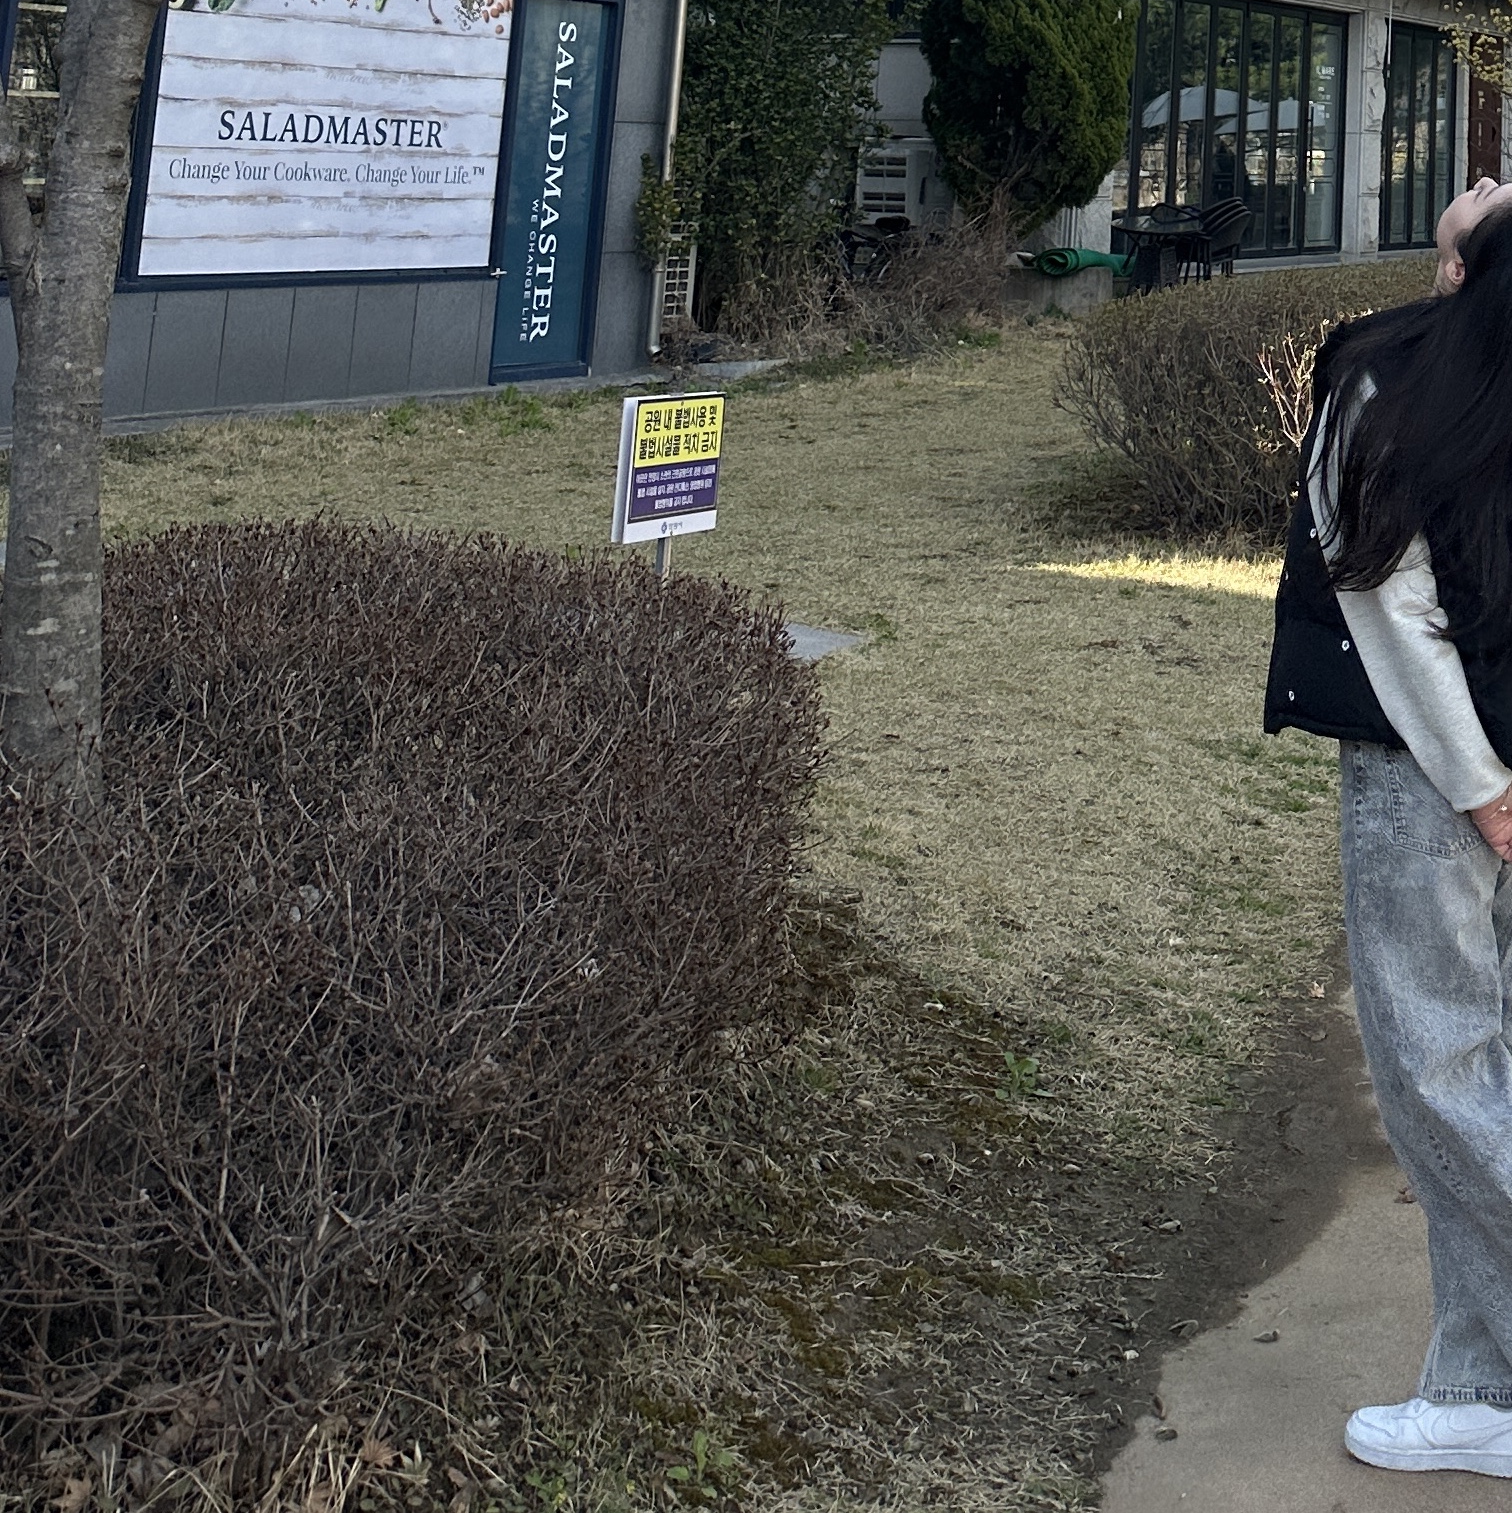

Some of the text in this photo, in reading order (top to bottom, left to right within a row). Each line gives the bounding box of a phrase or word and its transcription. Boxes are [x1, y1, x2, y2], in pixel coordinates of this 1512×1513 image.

[169, 158, 230, 184] Change
[234, 161, 271, 181] Your
[273, 161, 351, 183] Cookware.
[355, 163, 407, 187] Change
[411, 166, 441, 185] Your
[529, 21, 577, 343] SALADMASTER
[531, 199, 539, 223] WE
[524, 230, 537, 299] CHANGE
[644, 405, 717, 433] 공원 내 불법사용 및
[639, 430, 717, 460] 불법시설물 적치 금지
